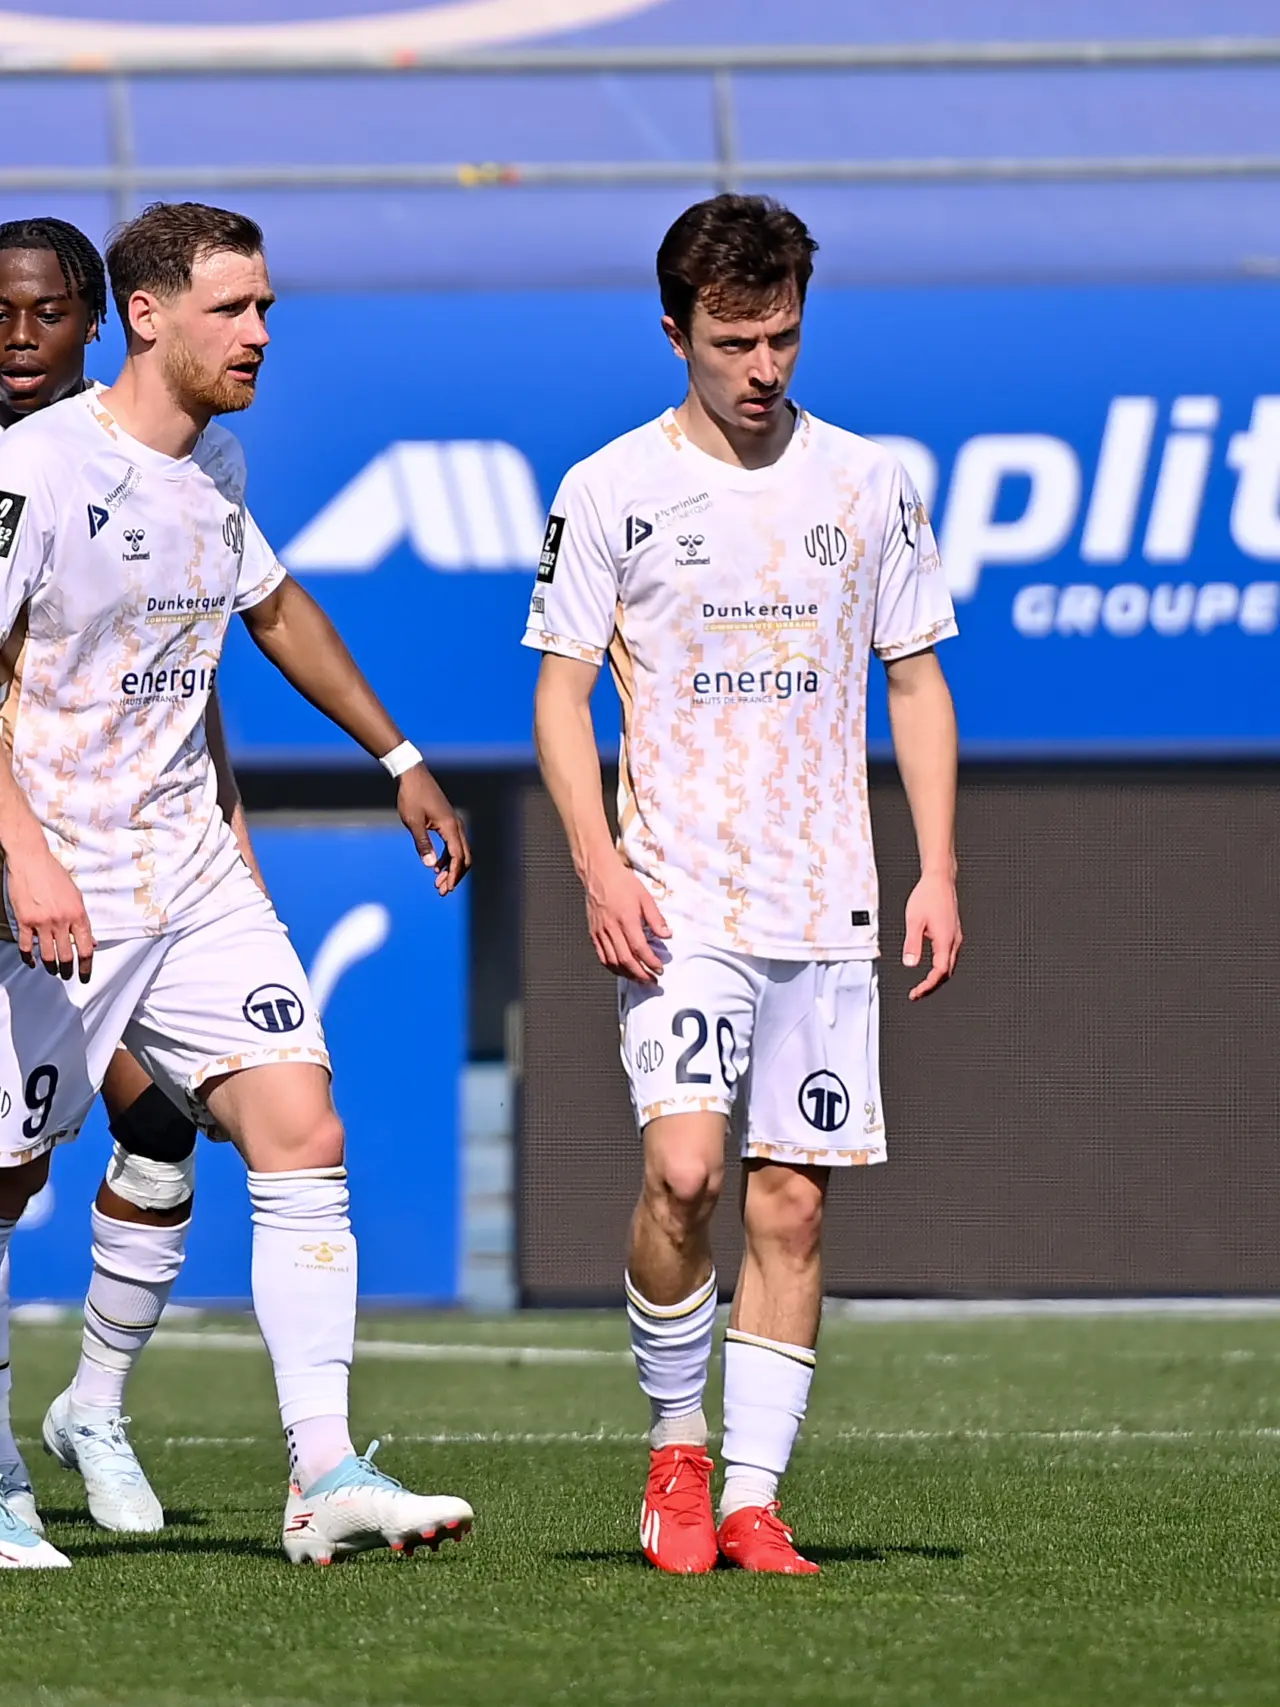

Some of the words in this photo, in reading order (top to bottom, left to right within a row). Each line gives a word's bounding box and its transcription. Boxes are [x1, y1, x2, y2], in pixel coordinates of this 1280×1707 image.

[122, 552, 151, 562] hummel
[804, 523, 847, 566] USLD
[675, 556, 711, 566] hummel
[147, 594, 226, 612] Dunkerque
[703, 601, 818, 619] Dunkerque
[1012, 583, 1280, 638] GROUPE
[693, 670, 819, 699] energia
[635, 1039, 664, 1073] USLD
[671, 1007, 739, 1091] 20
[22, 1064, 59, 1139] 9
